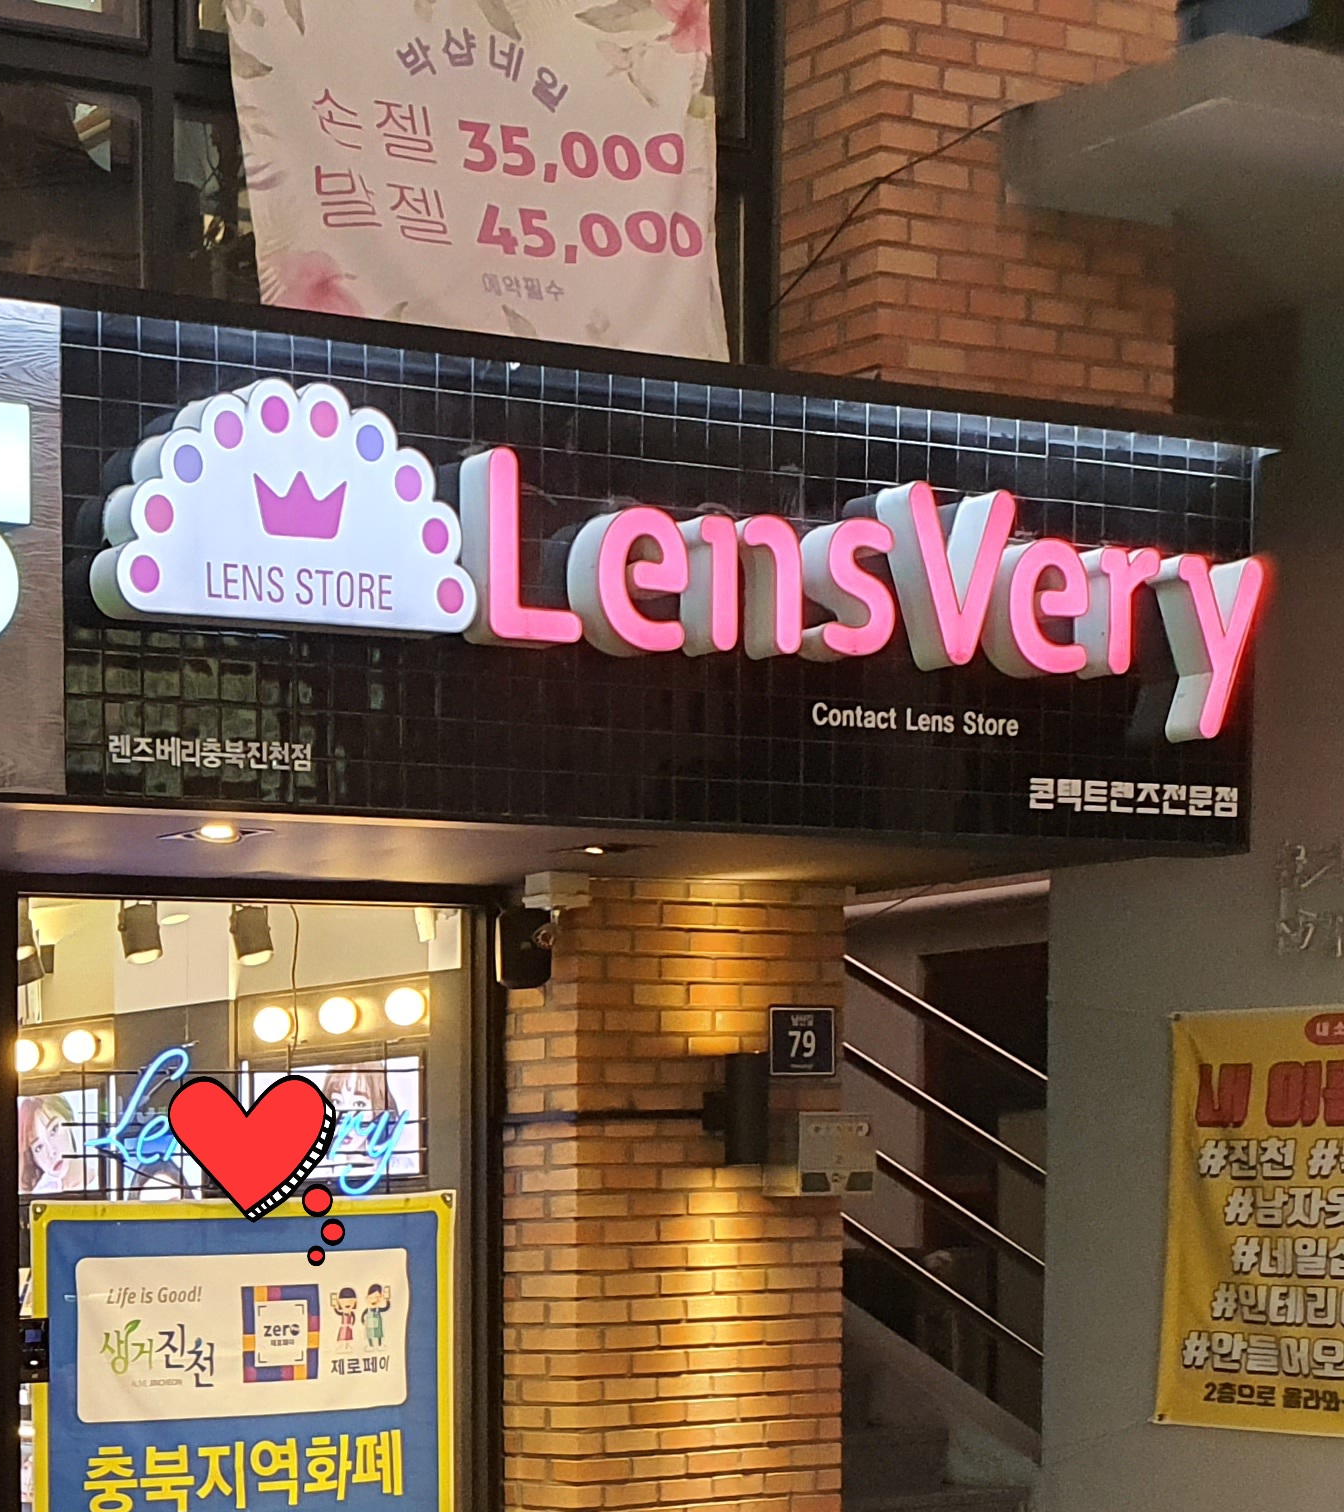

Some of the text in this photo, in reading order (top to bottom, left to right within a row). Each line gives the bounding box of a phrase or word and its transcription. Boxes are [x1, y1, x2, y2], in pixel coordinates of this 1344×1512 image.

[312, 88, 685, 184] 손젤 35,000
[314, 164, 704, 264] 발젤 45,000
[206, 561, 394, 612] LENS STORE
[467, 445, 1269, 742] LensVery
[811, 701, 1020, 738] Contact Lens Store
[108, 733, 313, 772] 렌즈베리충북진천점
[787, 1030, 817, 1058] 79
[1198, 1136, 1298, 1180] #진천
[106, 1286, 203, 1308] Life is Good!
[1211, 1281, 1344, 1329] #인테리
[263, 1323, 301, 1338] zero
[100, 1319, 216, 1389] 생거진천
[330, 1356, 391, 1376] 제로페이
